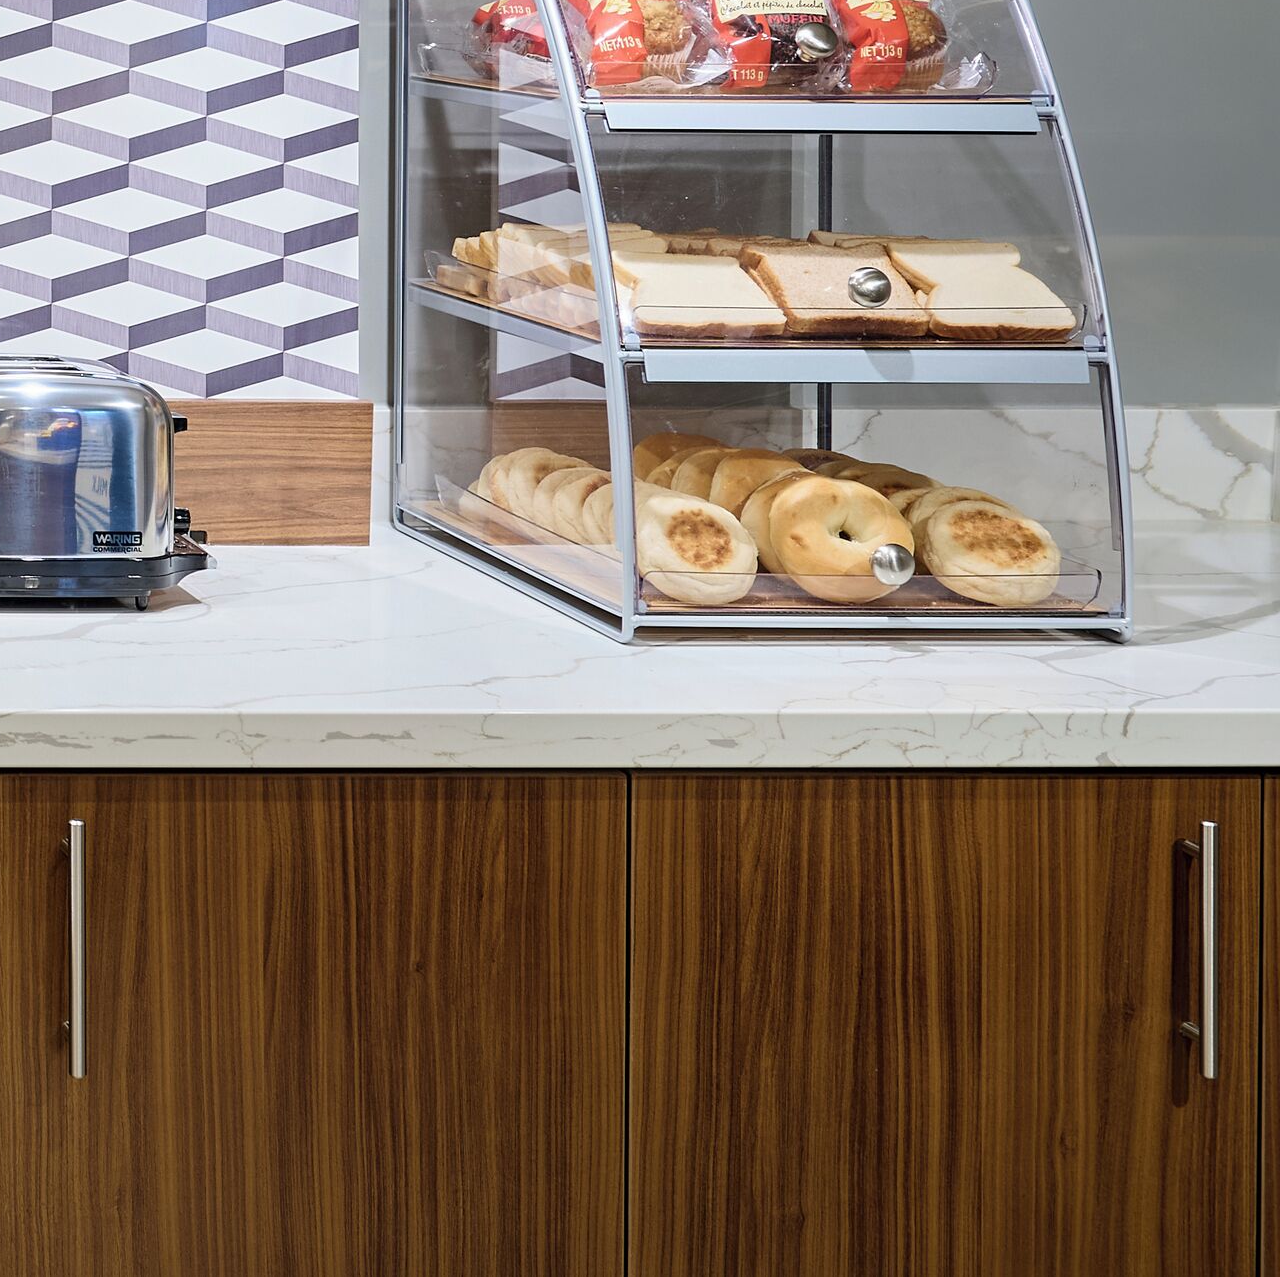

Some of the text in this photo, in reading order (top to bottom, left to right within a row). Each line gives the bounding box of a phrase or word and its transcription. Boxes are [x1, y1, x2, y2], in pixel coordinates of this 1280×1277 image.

[767, 14, 824, 24] MUFFIN
[600, 38, 618, 53] NET
[860, 47, 877, 58] NET
[896, 46, 903, 58] g
[740, 69, 756, 80] 113
[757, 70, 764, 81] g
[95, 534, 141, 546] WARING
[92, 546, 142, 554] COMMERCIAL
